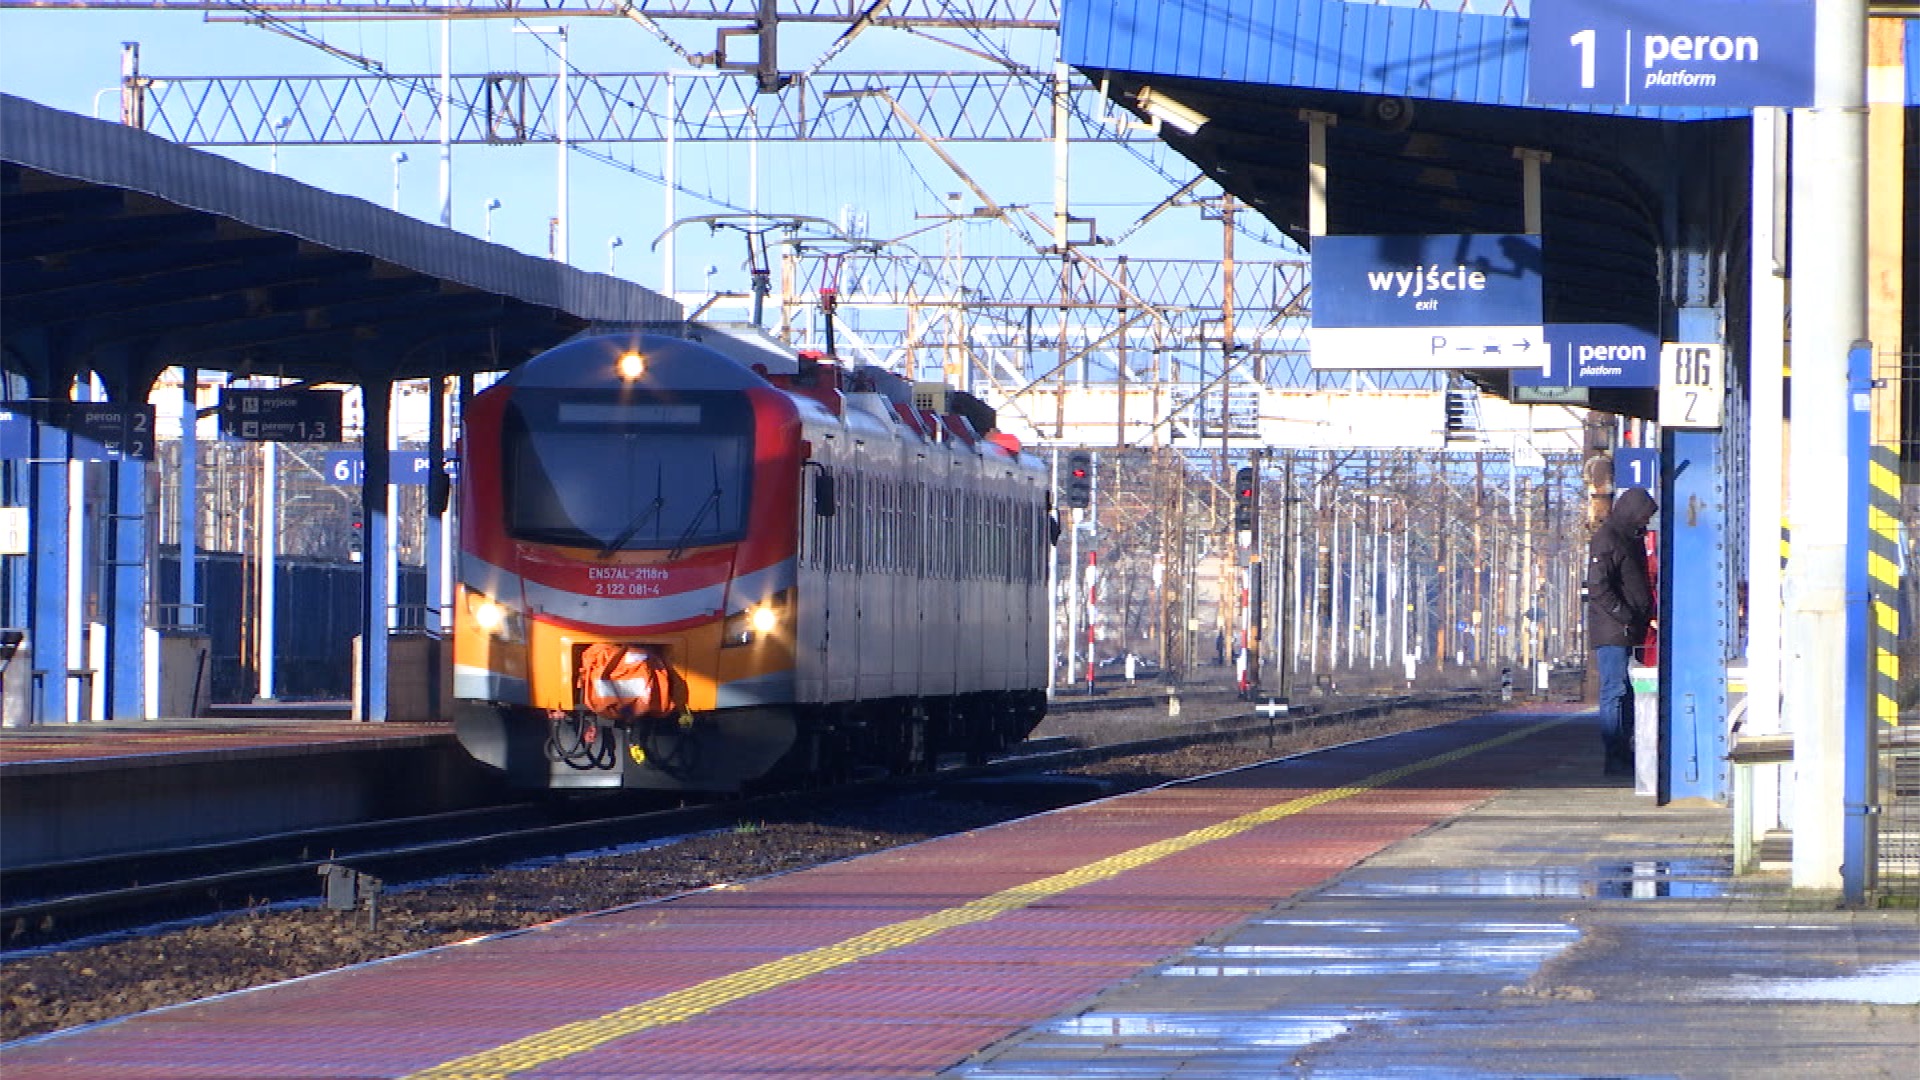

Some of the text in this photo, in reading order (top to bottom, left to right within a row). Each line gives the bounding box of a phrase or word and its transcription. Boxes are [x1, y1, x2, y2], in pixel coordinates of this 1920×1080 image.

[1570, 29, 1759, 89] 1 peron
[1645, 69, 1717, 88] platform
[1367, 263, 1487, 298] wyjście
[1415, 297, 1439, 311] exit
[1579, 345, 1647, 365] peron
[1579, 365, 1622, 377] platform
[1684, 391, 1698, 423] 2
[132, 413, 147, 433] 2
[298, 421, 326, 441] 1,3
[131, 441, 144, 457] 2
[334, 459, 350, 481] 6
[1629, 459, 1642, 484] 1
[595, 583, 660, 595] 2 122 081-4
